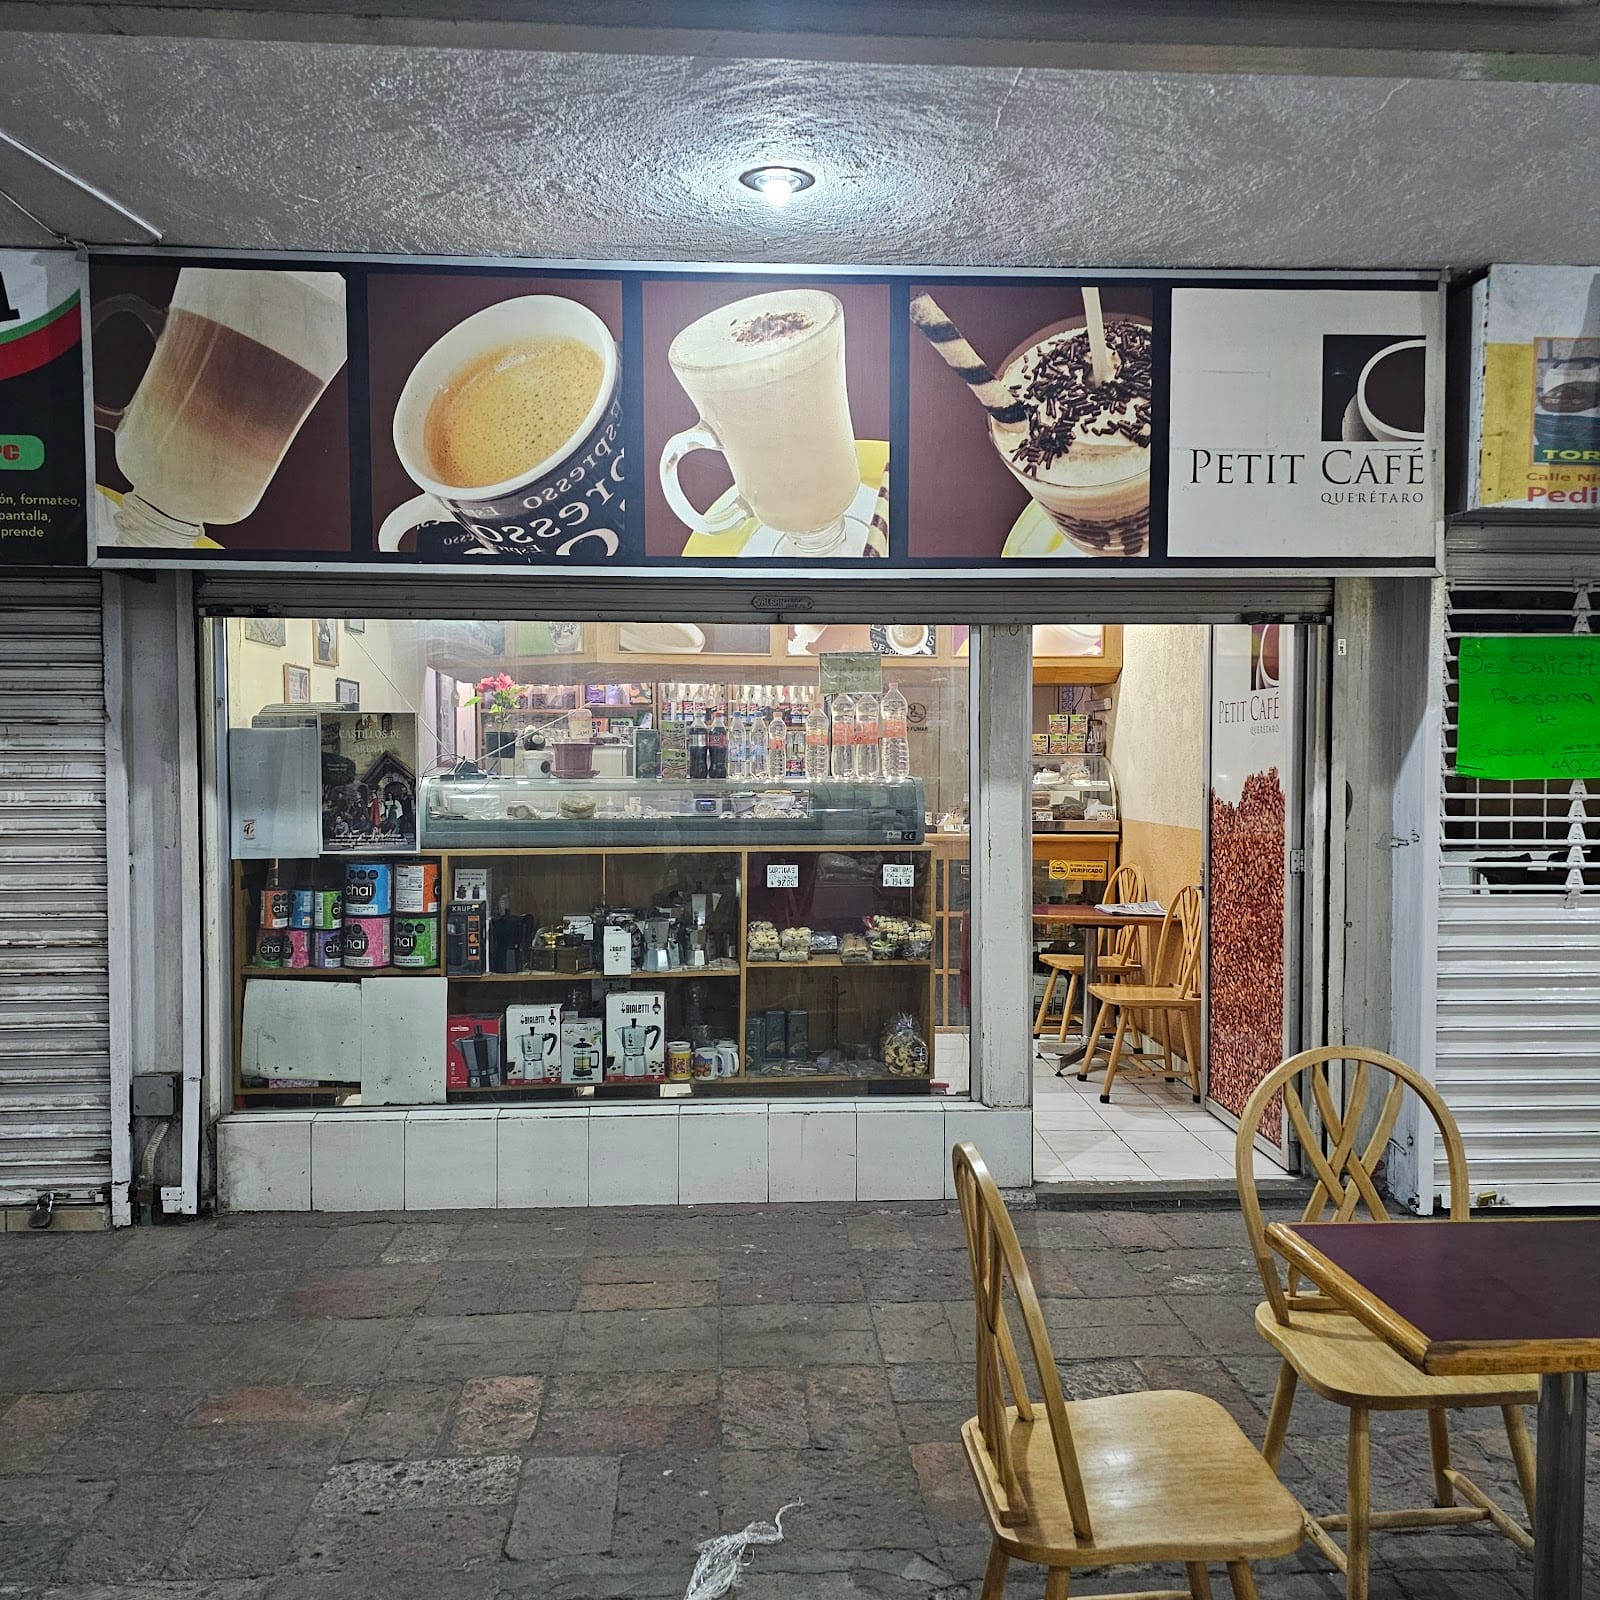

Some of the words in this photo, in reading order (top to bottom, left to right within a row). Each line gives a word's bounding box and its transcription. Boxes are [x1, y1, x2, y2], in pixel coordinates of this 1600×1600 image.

[1190, 449, 1305, 485] PETIT
[1321, 447, 1424, 485] CAFÉ
[1526, 472, 1571, 482] Calle
[20, 493, 81, 507] formateo,
[1321, 490, 1424, 505] QUERÉTARO
[1527, 486, 1599, 504] Pedi
[1, 525, 44, 539] prende
[1462, 644, 1502, 674] Se
[1490, 687, 1593, 706] Persona
[1219, 700, 1247, 724] PETIT
[1250, 691, 1279, 721] CAFÉ
[1535, 708, 1558, 726] de
[346, 883, 373, 896] chai
